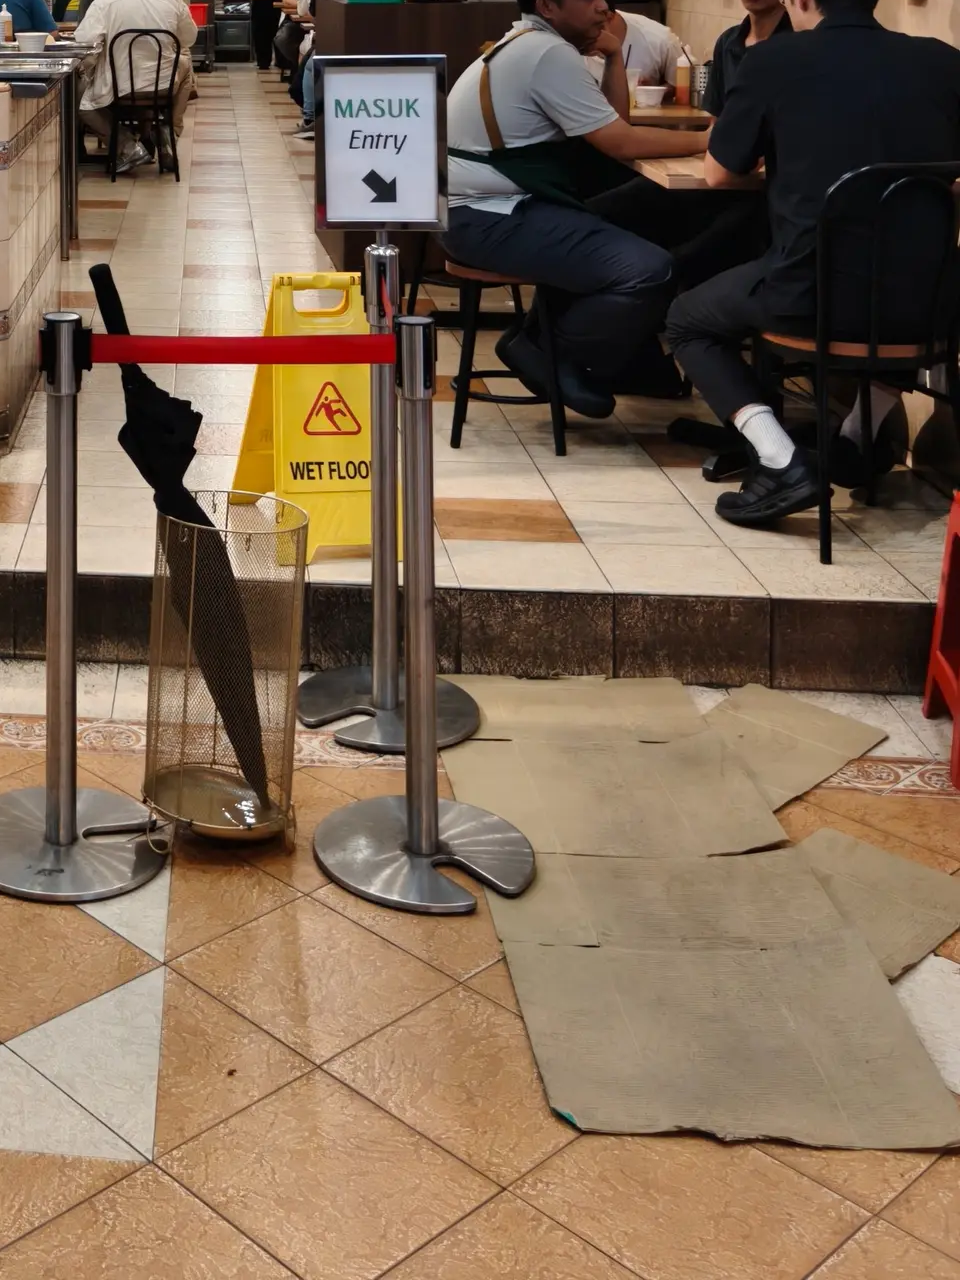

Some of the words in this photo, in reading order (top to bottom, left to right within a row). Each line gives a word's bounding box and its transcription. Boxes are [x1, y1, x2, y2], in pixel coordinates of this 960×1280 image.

[334, 98, 420, 118] MASUK
[349, 130, 407, 155] Entry
[289, 461, 325, 480] WET
[328, 460, 371, 480] FLOO
